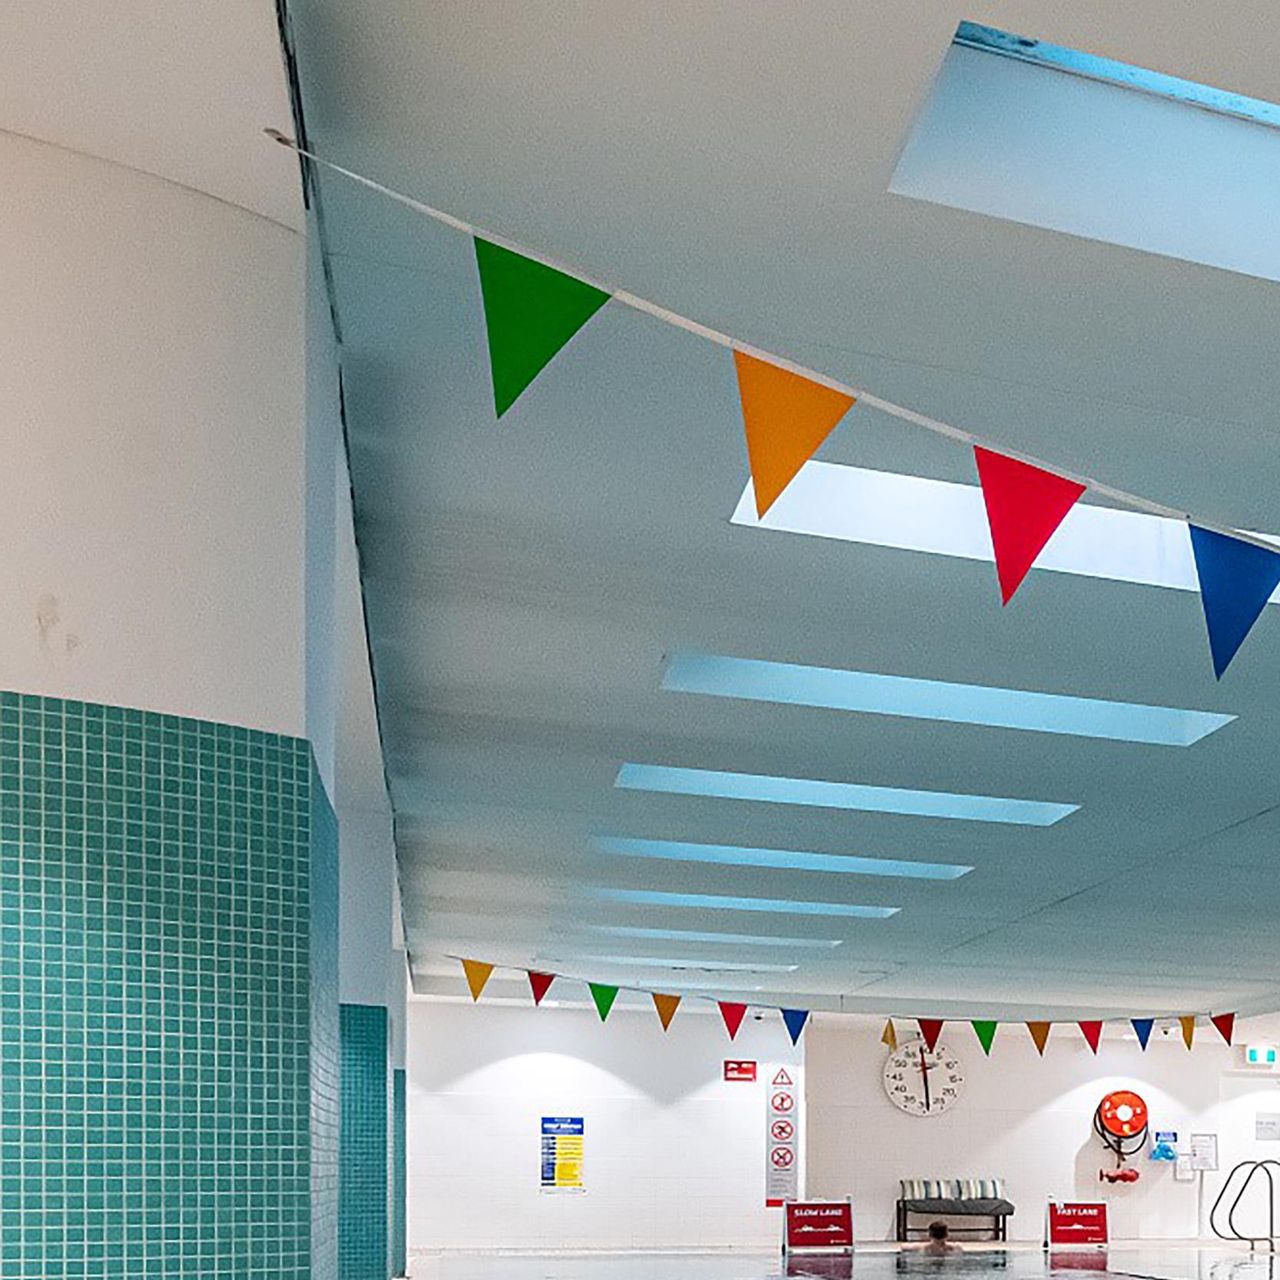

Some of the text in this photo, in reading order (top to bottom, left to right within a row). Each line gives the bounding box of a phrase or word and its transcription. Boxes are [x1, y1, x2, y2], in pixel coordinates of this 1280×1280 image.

[894, 1059, 908, 1068] 50
[891, 1072, 903, 1081] 45
[894, 1085, 907, 1093] 40
[794, 1208, 843, 1216] SLOW LANE
[1078, 1208, 1098, 1216] LANE
